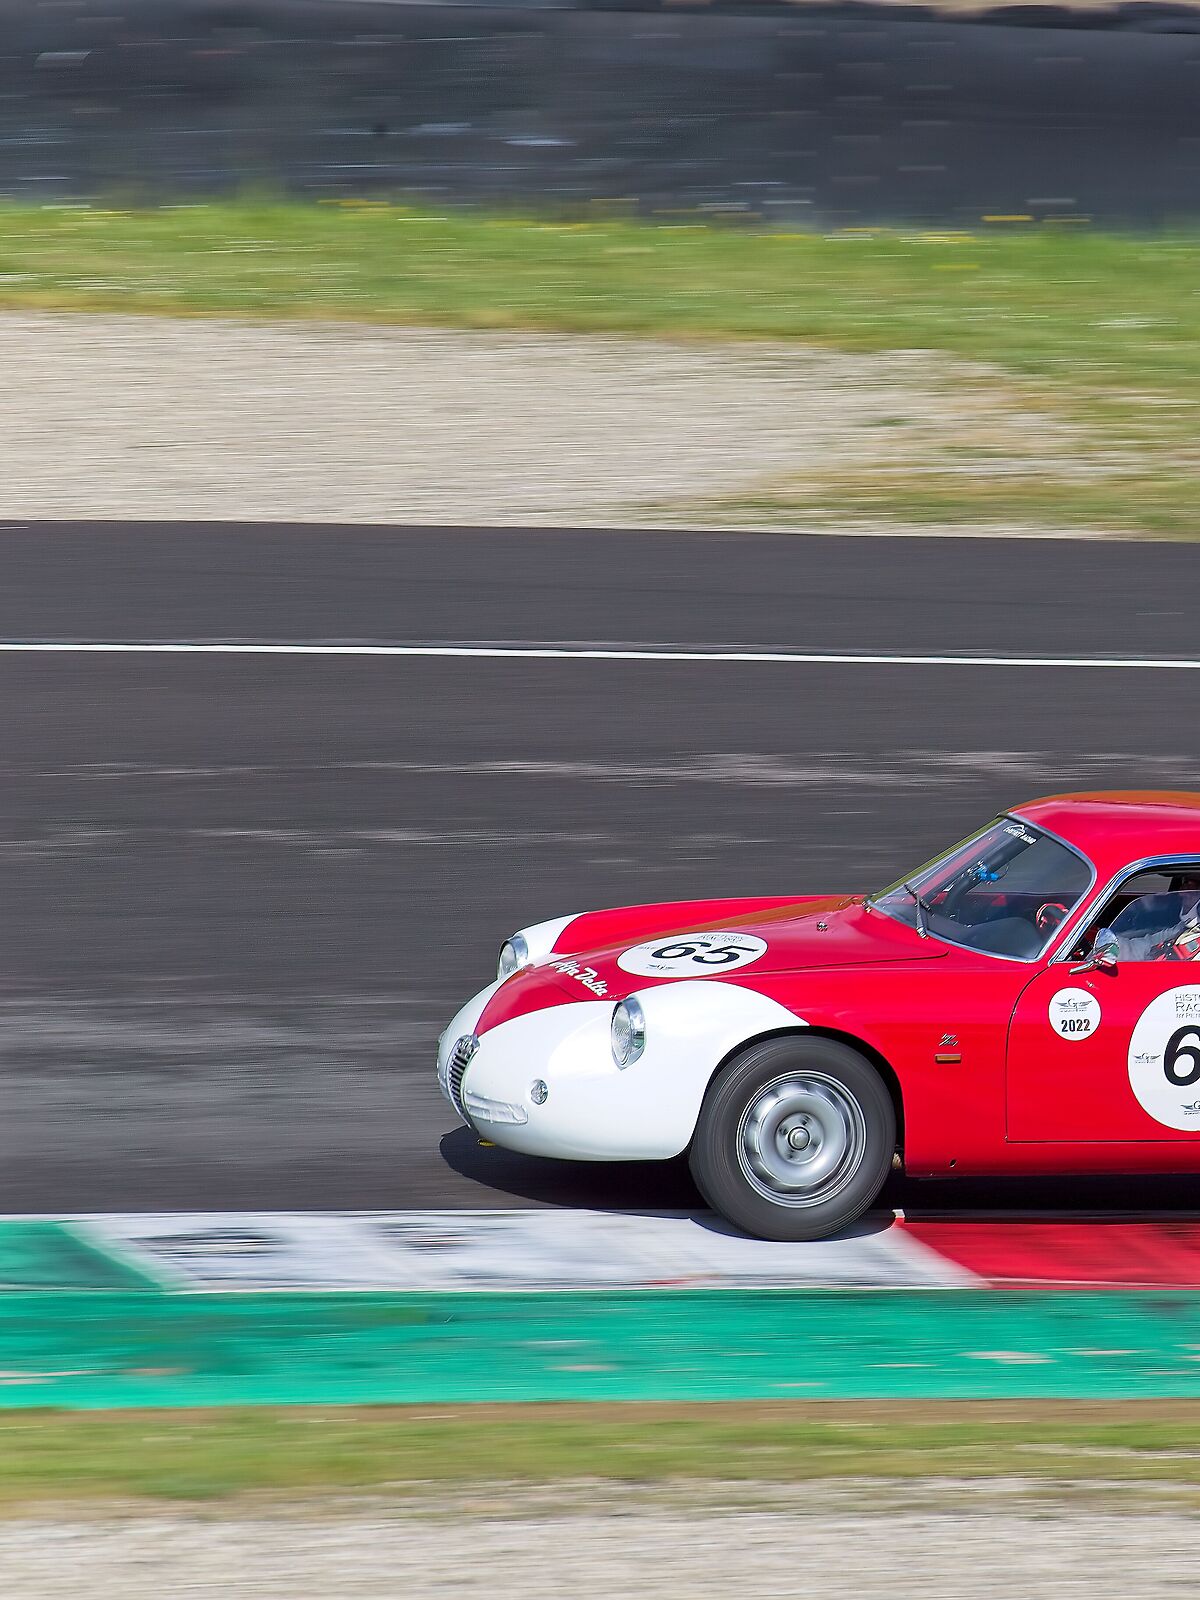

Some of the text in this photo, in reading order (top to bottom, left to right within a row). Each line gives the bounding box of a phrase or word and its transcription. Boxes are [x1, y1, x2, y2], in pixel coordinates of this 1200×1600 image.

[651, 942, 759, 964] 65
[574, 967, 608, 996] Delta
[1061, 1019, 1091, 1032] 2022
